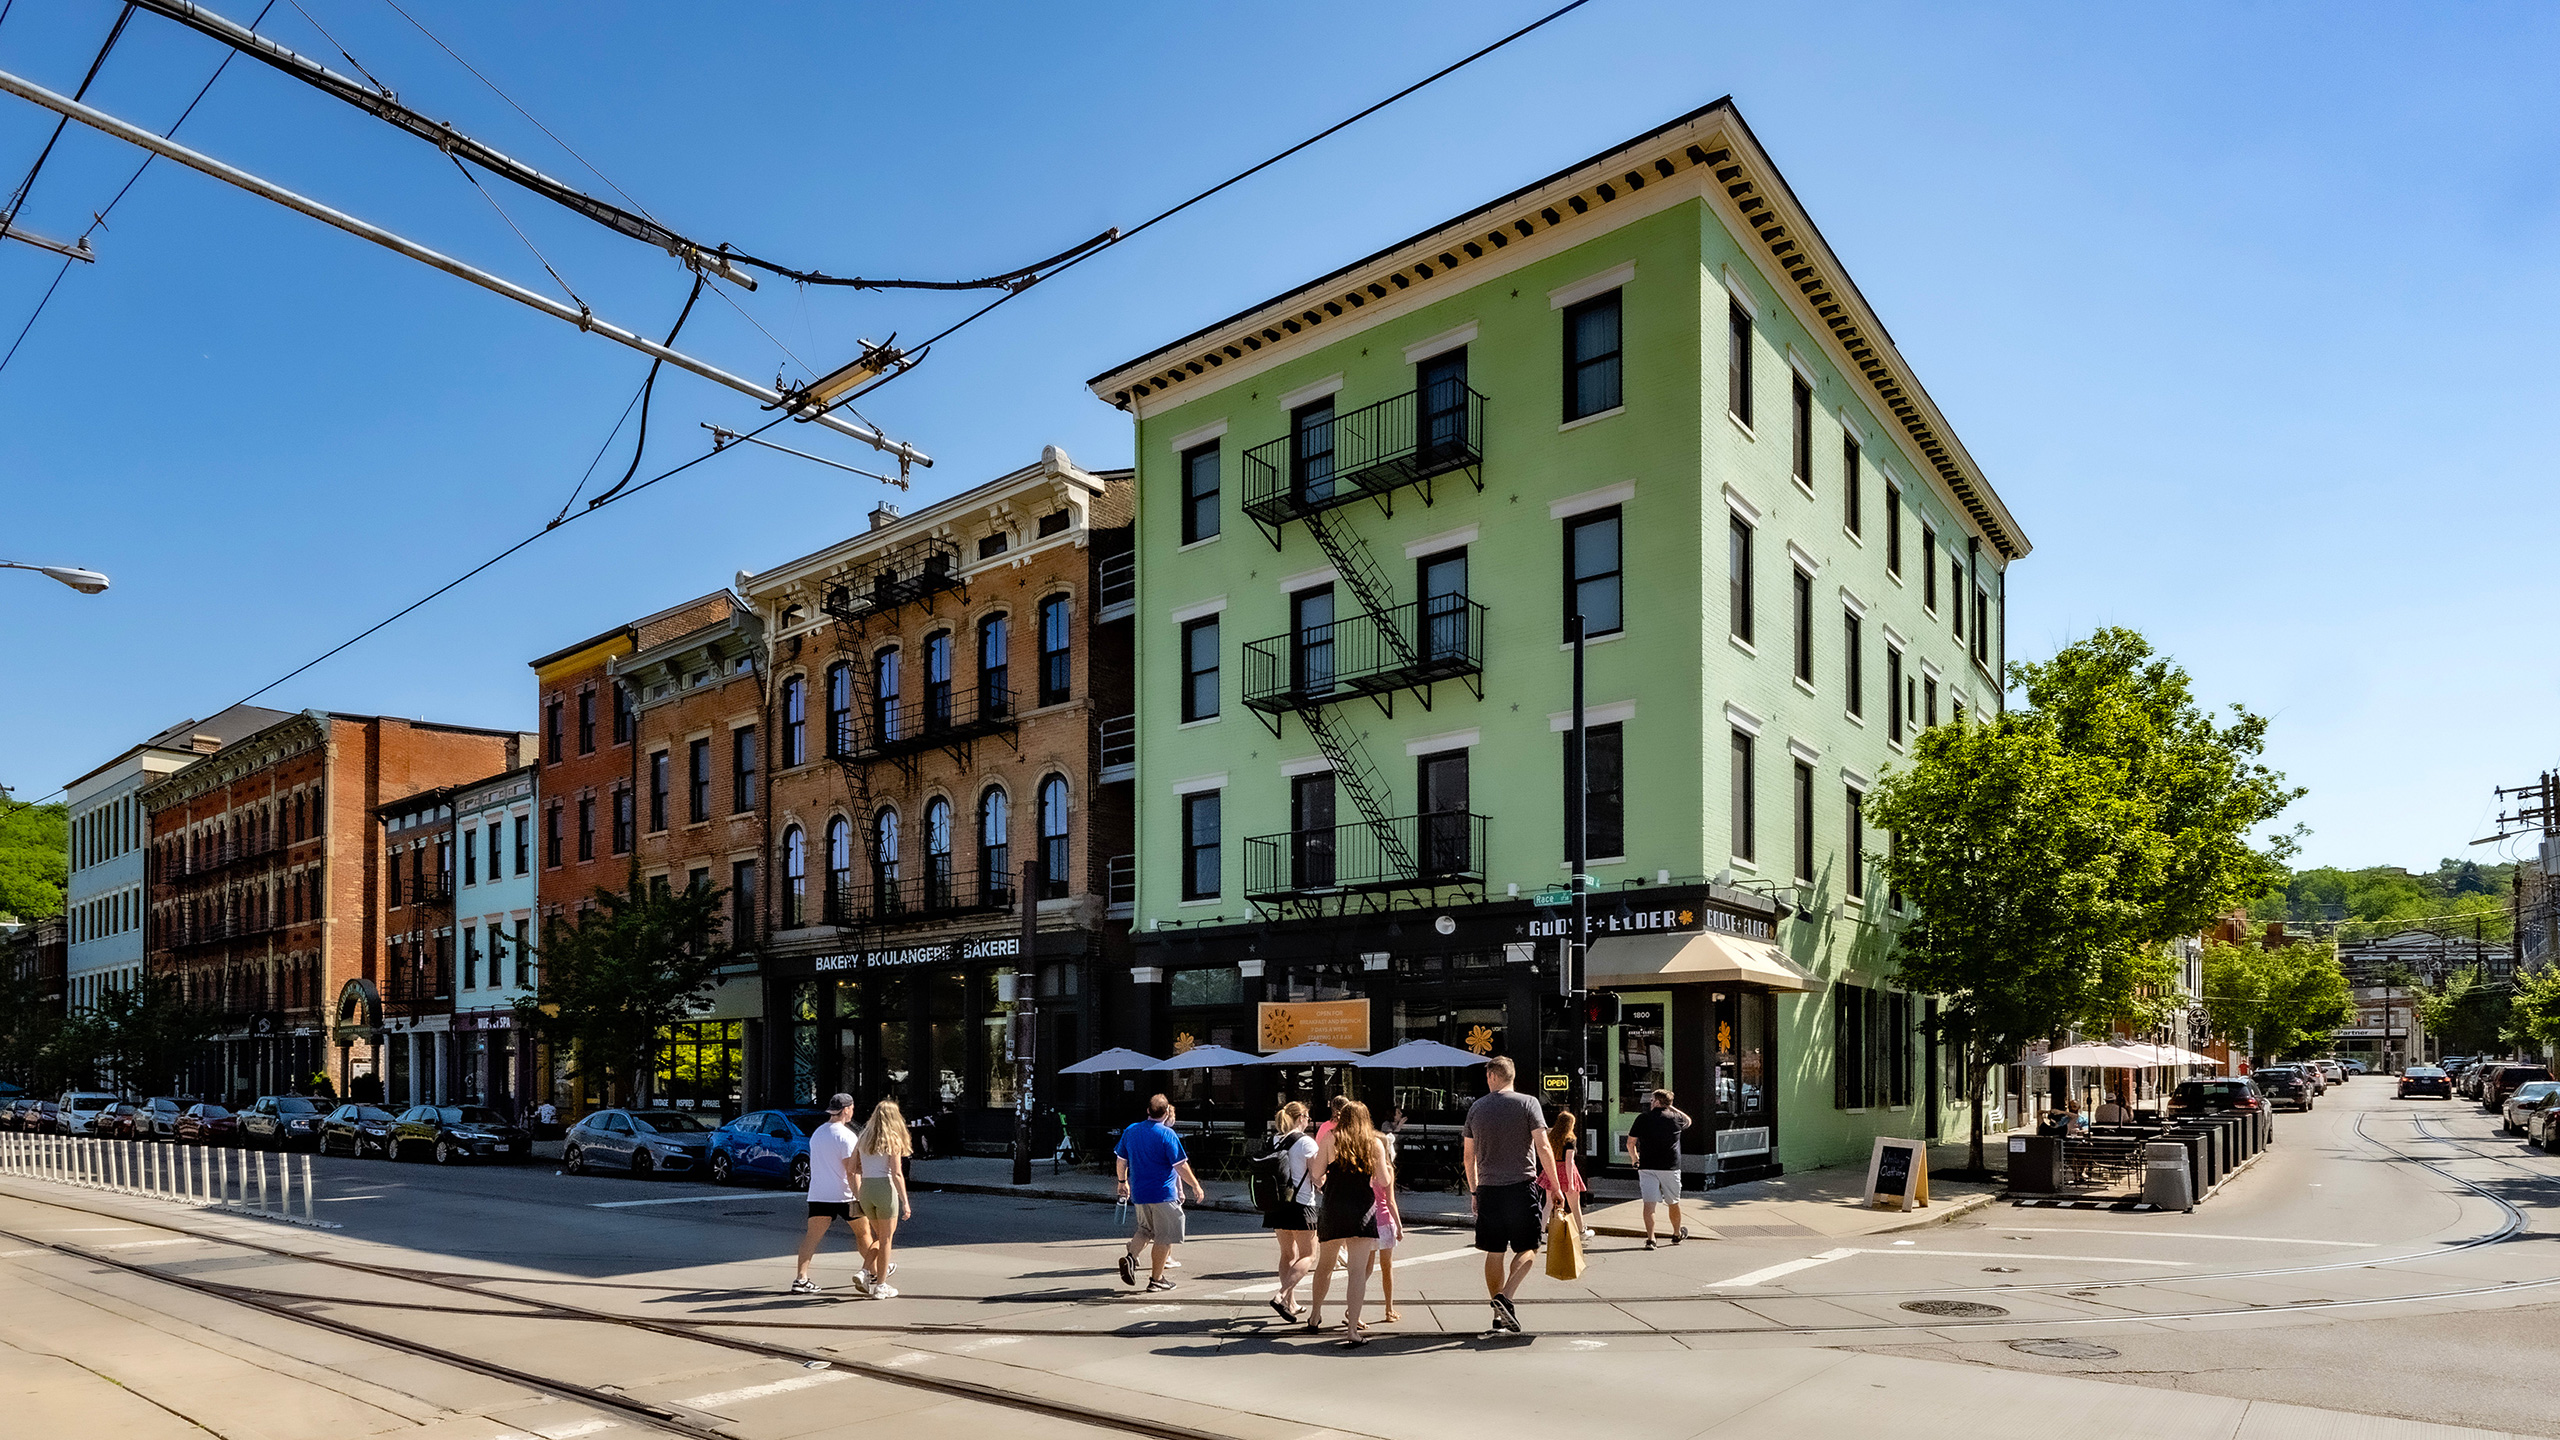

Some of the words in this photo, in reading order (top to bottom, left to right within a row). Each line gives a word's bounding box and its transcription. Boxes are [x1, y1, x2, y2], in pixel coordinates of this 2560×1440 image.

[1536, 895, 1554, 904] Race
[1529, 916, 1593, 937] GOOE
[1609, 910, 1677, 931] ELDER
[1706, 909, 1737, 932] GOOSE
[1743, 918, 1769, 939] ELDER
[815, 953, 859, 971] BAKERY
[1633, 1011, 1651, 1019] 1800
[1546, 1079, 1566, 1087] OPEN
[652, 1098, 669, 1107] VINTAGE
[675, 1098, 695, 1107] INSPIRED
[701, 1099, 721, 1108] APPAREL
